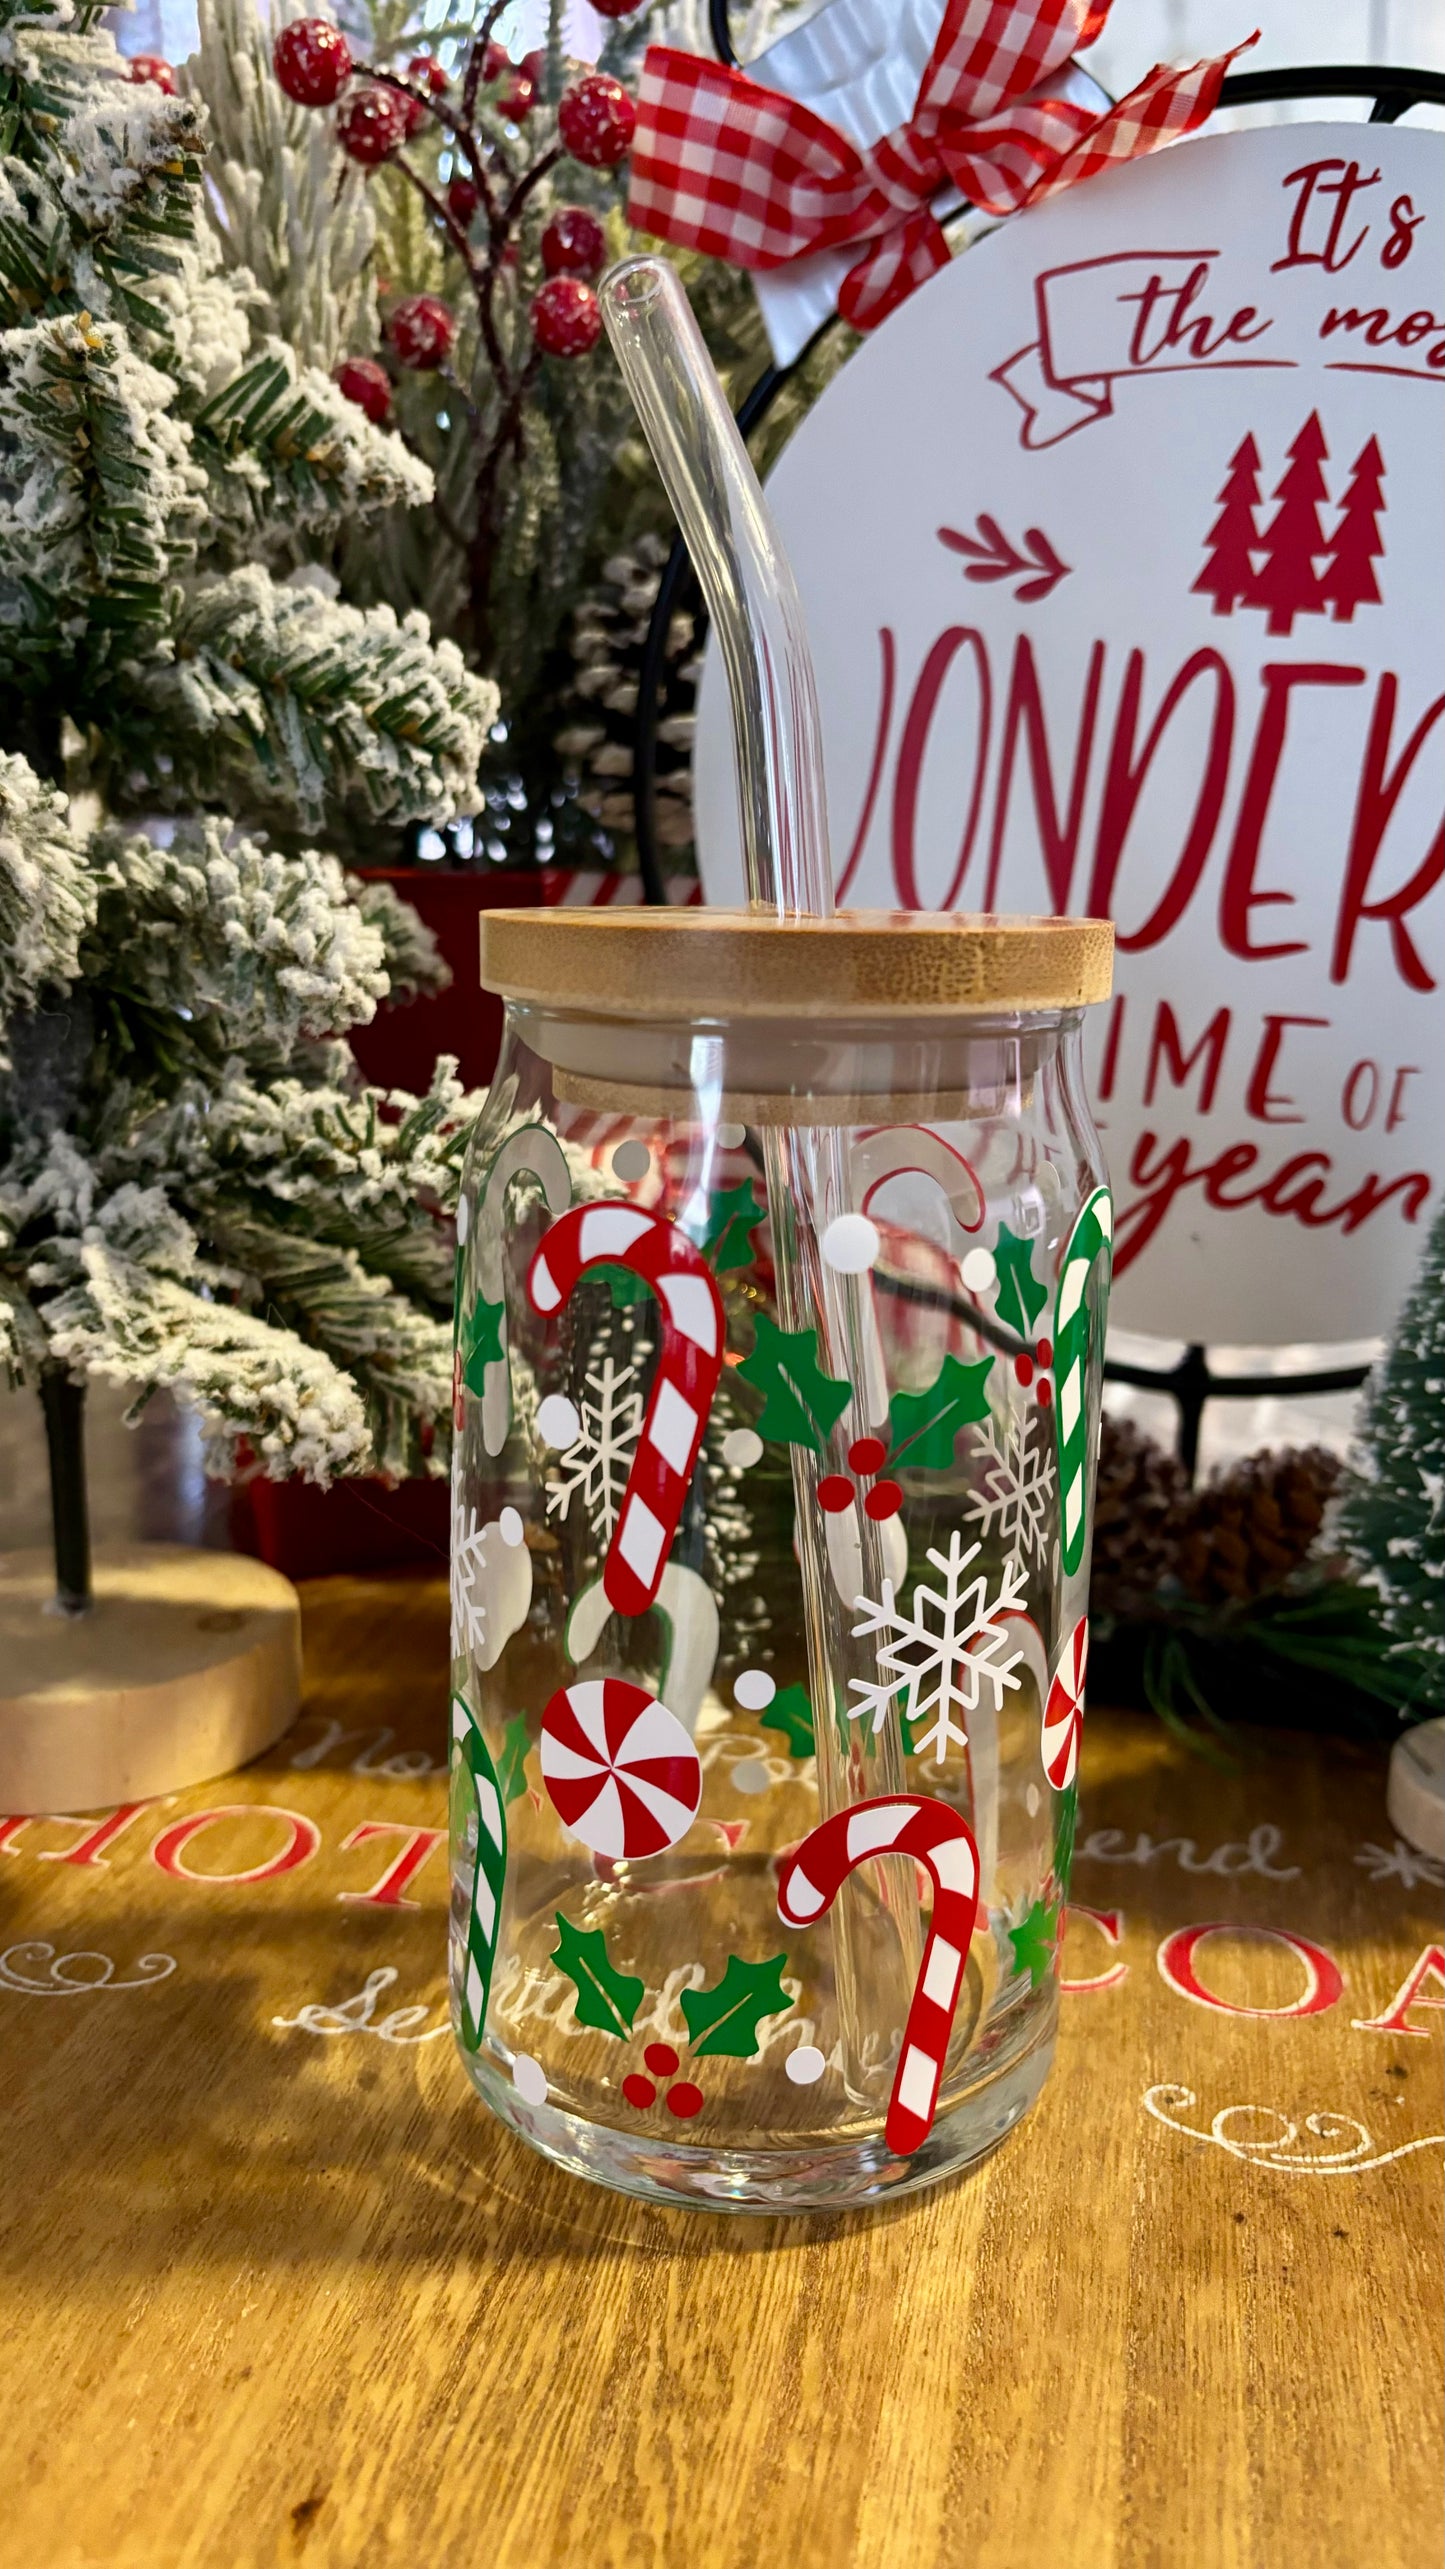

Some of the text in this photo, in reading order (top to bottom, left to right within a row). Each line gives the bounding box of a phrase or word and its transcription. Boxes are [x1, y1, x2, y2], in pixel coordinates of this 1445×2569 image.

[1116, 262, 1274, 366] the
[832, 625, 1445, 993] ONDER
[1097, 993, 1332, 1124] IME
[1112, 1130, 1431, 1277] year
